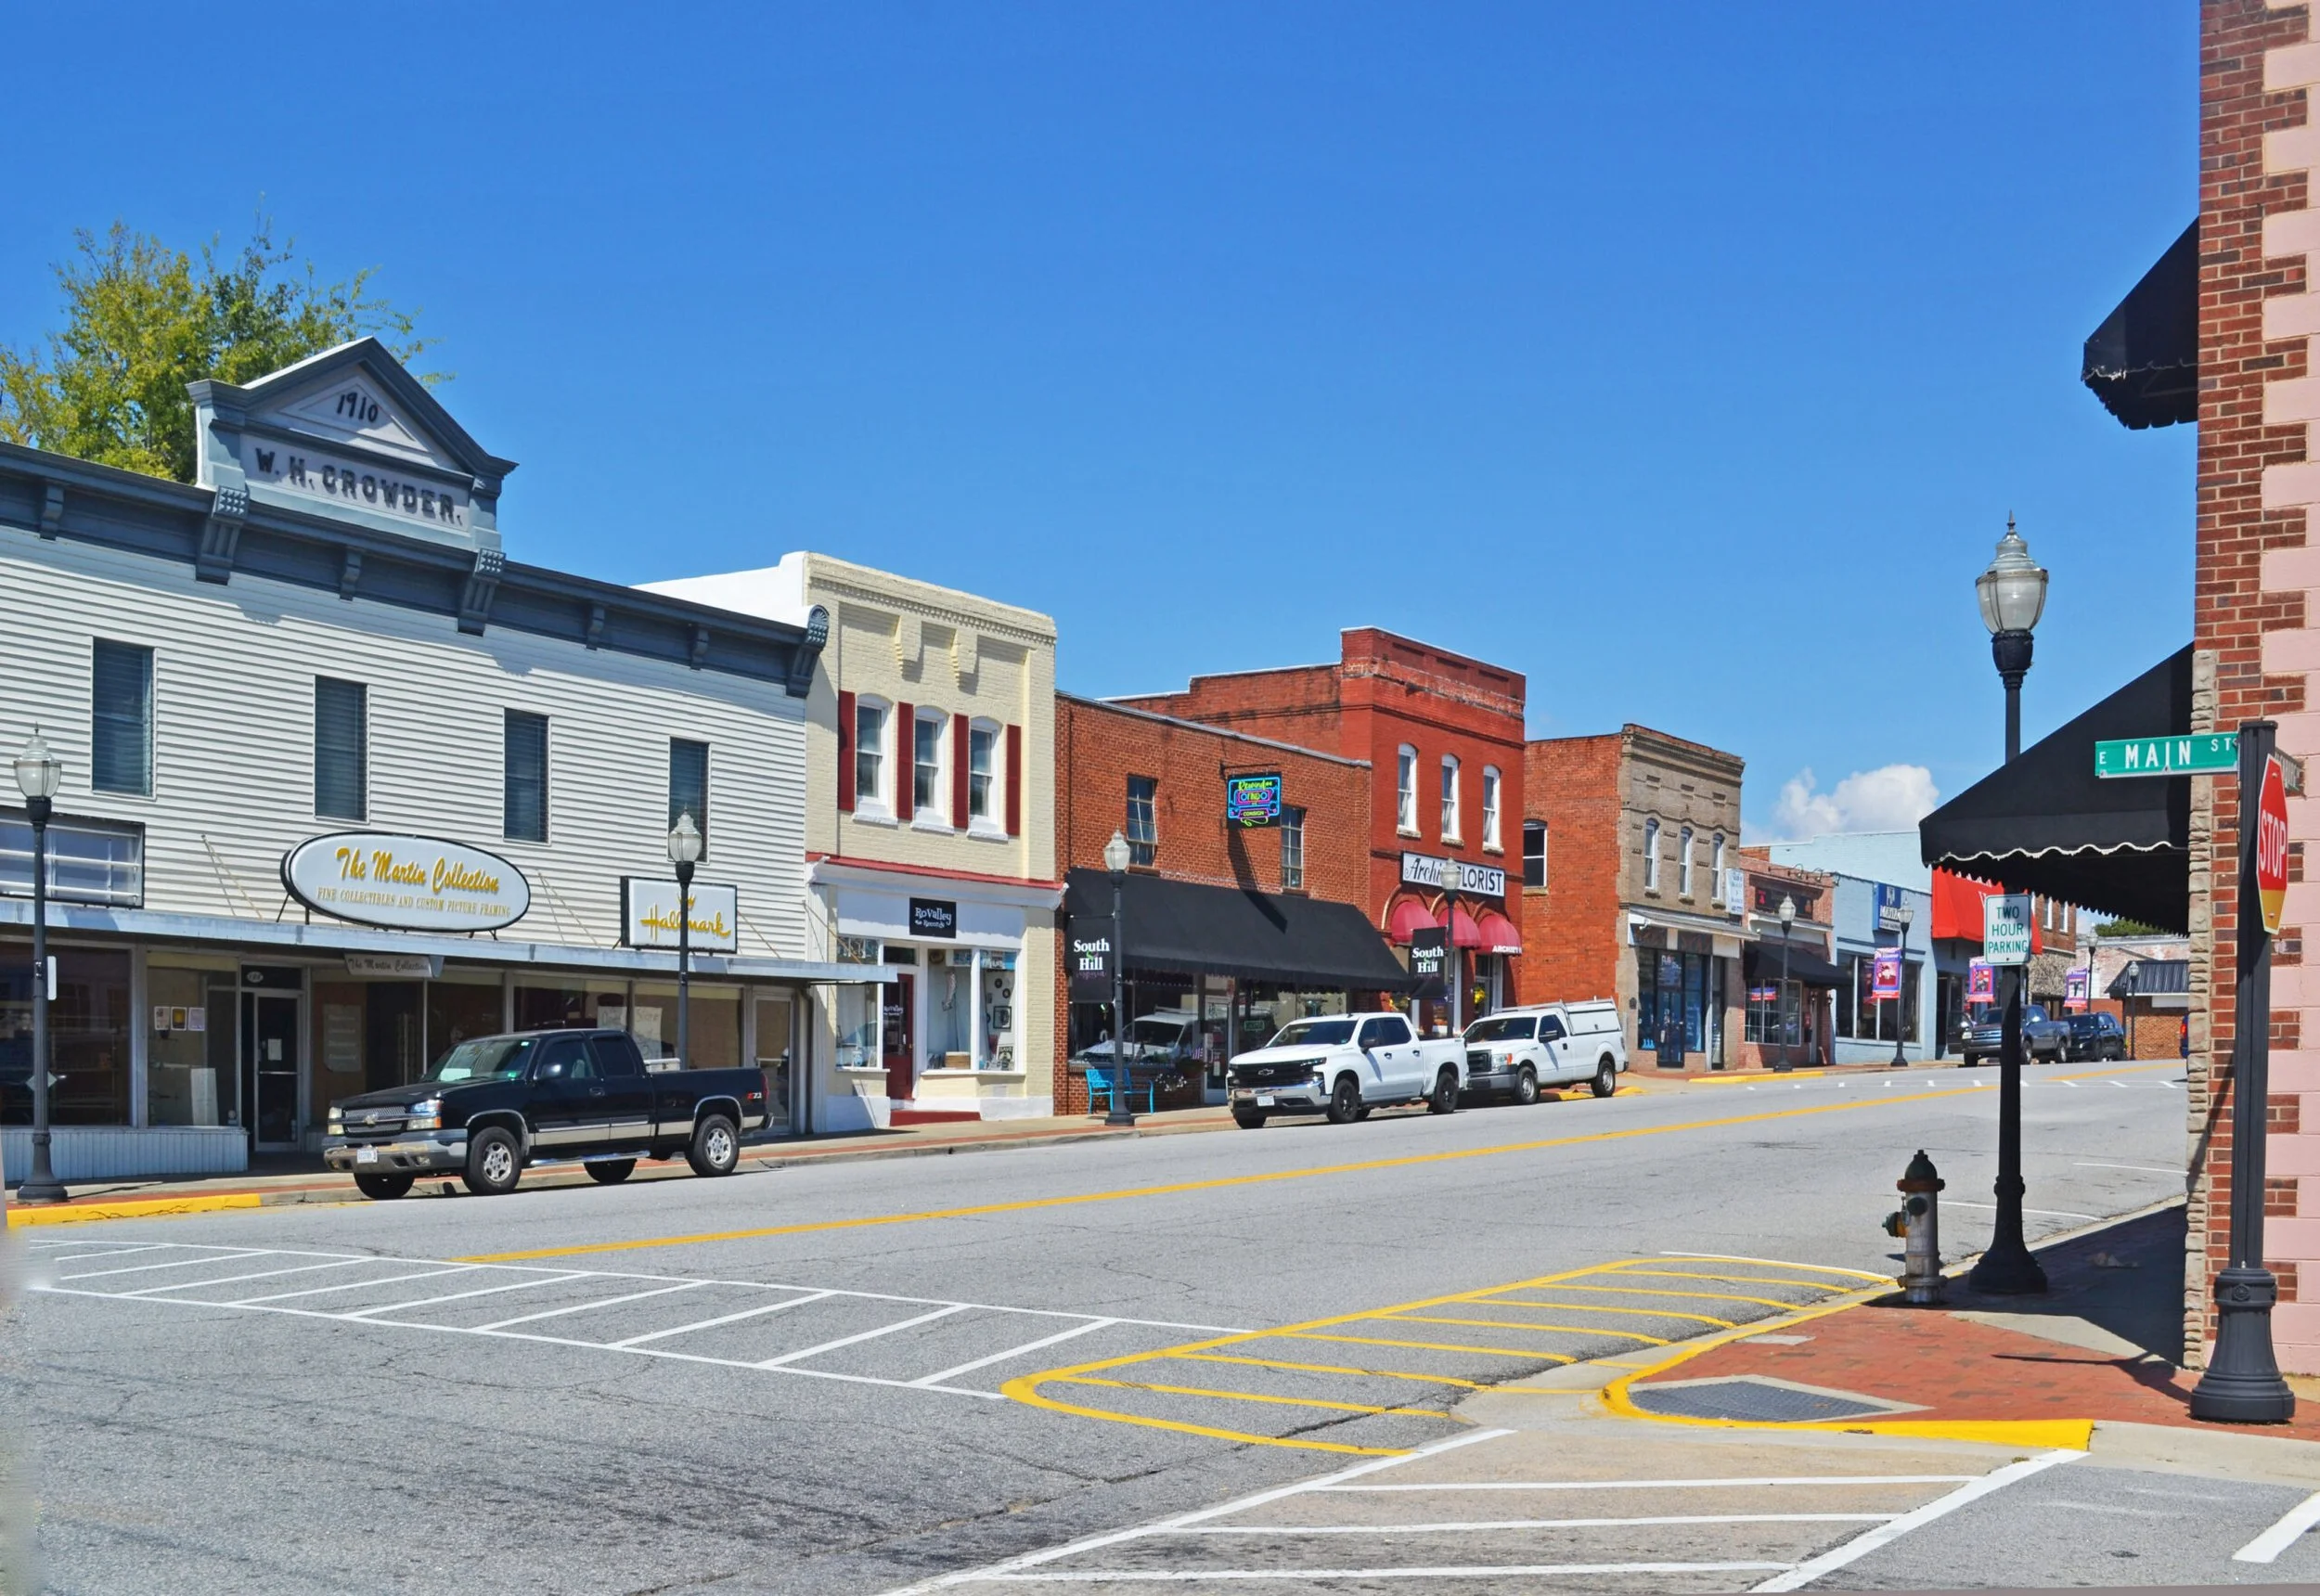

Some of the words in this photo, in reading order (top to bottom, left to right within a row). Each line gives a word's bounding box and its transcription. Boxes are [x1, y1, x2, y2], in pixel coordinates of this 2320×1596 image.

[337, 392, 379, 423] 1910
[255, 447, 280, 476] W.
[290, 456, 316, 490] H.
[322, 465, 463, 526] CROWDER.
[2099, 752, 2107, 766] E
[2125, 740, 2191, 769] MAIN
[2210, 737, 2231, 752] ST
[2260, 809, 2287, 879] STOP
[335, 846, 367, 881] The
[372, 849, 426, 883] Martin
[432, 856, 499, 895] Collection
[1405, 857, 1442, 885] Archi
[1457, 866, 1502, 893] LORIST
[317, 887, 337, 902] FINE
[341, 889, 394, 907] COLLECTIBLES
[398, 895, 414, 907] AND
[417, 896, 444, 912] CUSTOM
[447, 900, 477, 914] PICTURE
[480, 903, 510, 918] FRAMING
[1996, 906, 2020, 919] TWO
[1991, 923, 2024, 936] HOUR
[1073, 937, 1111, 953] South
[1411, 946, 1444, 959] South
[1988, 939, 2029, 954] PARKING
[1079, 956, 1103, 971] Hill
[1417, 961, 1438, 973] Hill
